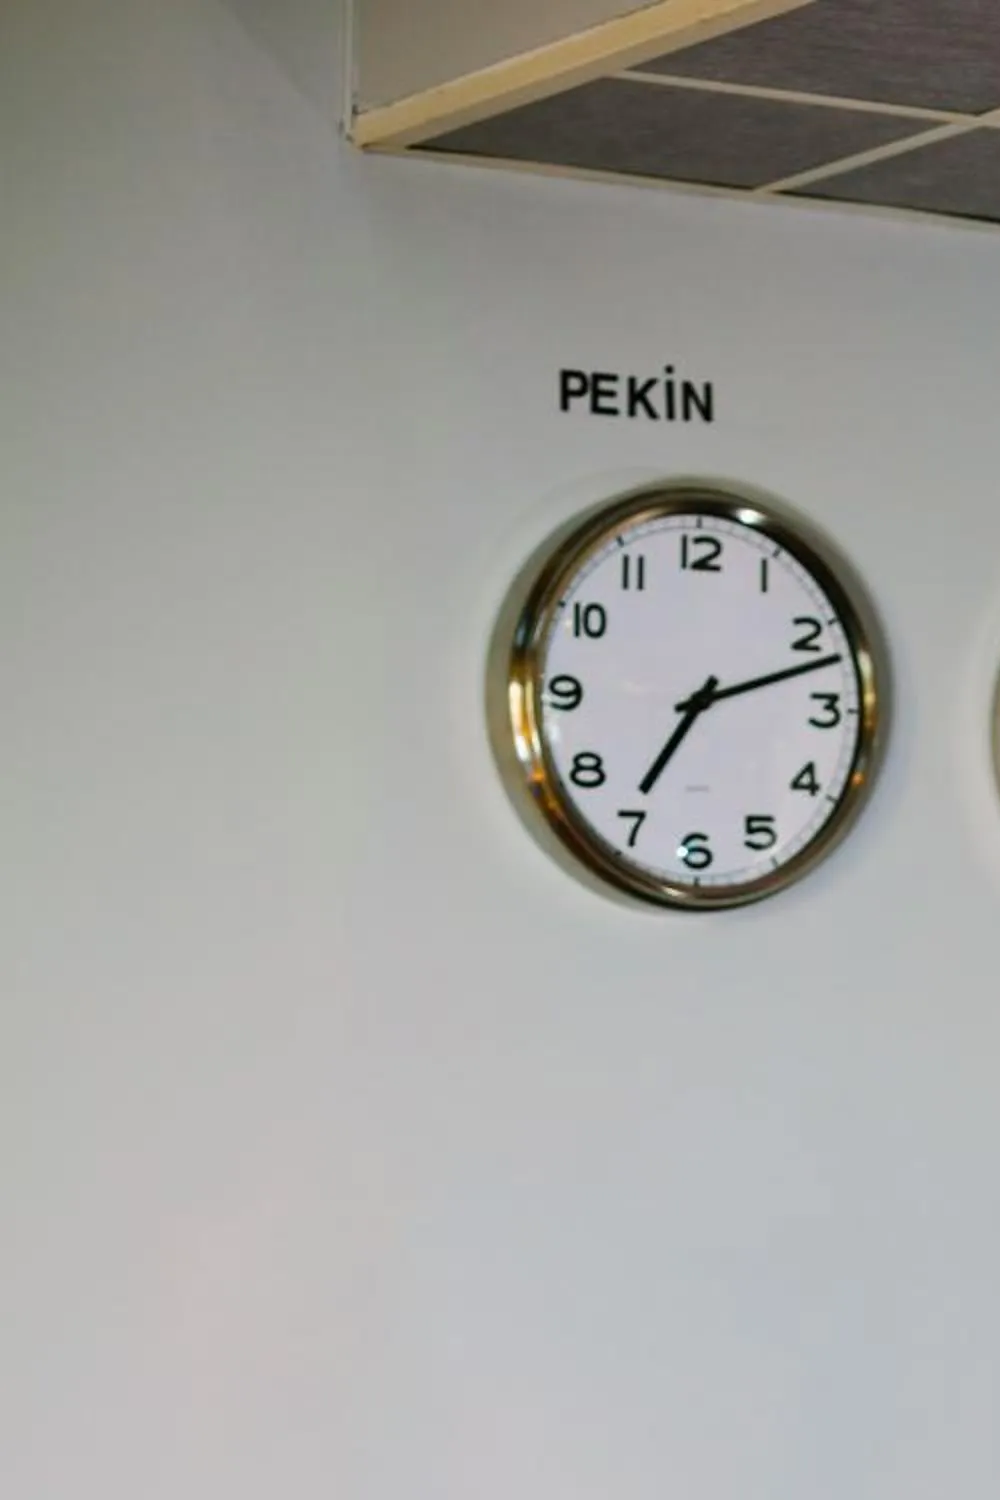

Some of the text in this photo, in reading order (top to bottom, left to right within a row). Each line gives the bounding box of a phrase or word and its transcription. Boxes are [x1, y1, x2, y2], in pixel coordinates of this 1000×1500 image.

[681, 534, 723, 573] 12
[621, 554, 646, 591] 11
[760, 558, 769, 593] 1
[573, 602, 608, 640] 10
[791, 617, 823, 653] 2
[548, 674, 584, 712] 9
[808, 692, 843, 729] 3
[569, 751, 607, 789] 8
[790, 761, 822, 797] 4
[617, 809, 648, 848] 7
[743, 814, 778, 851] 5
[680, 832, 713, 871] 6
